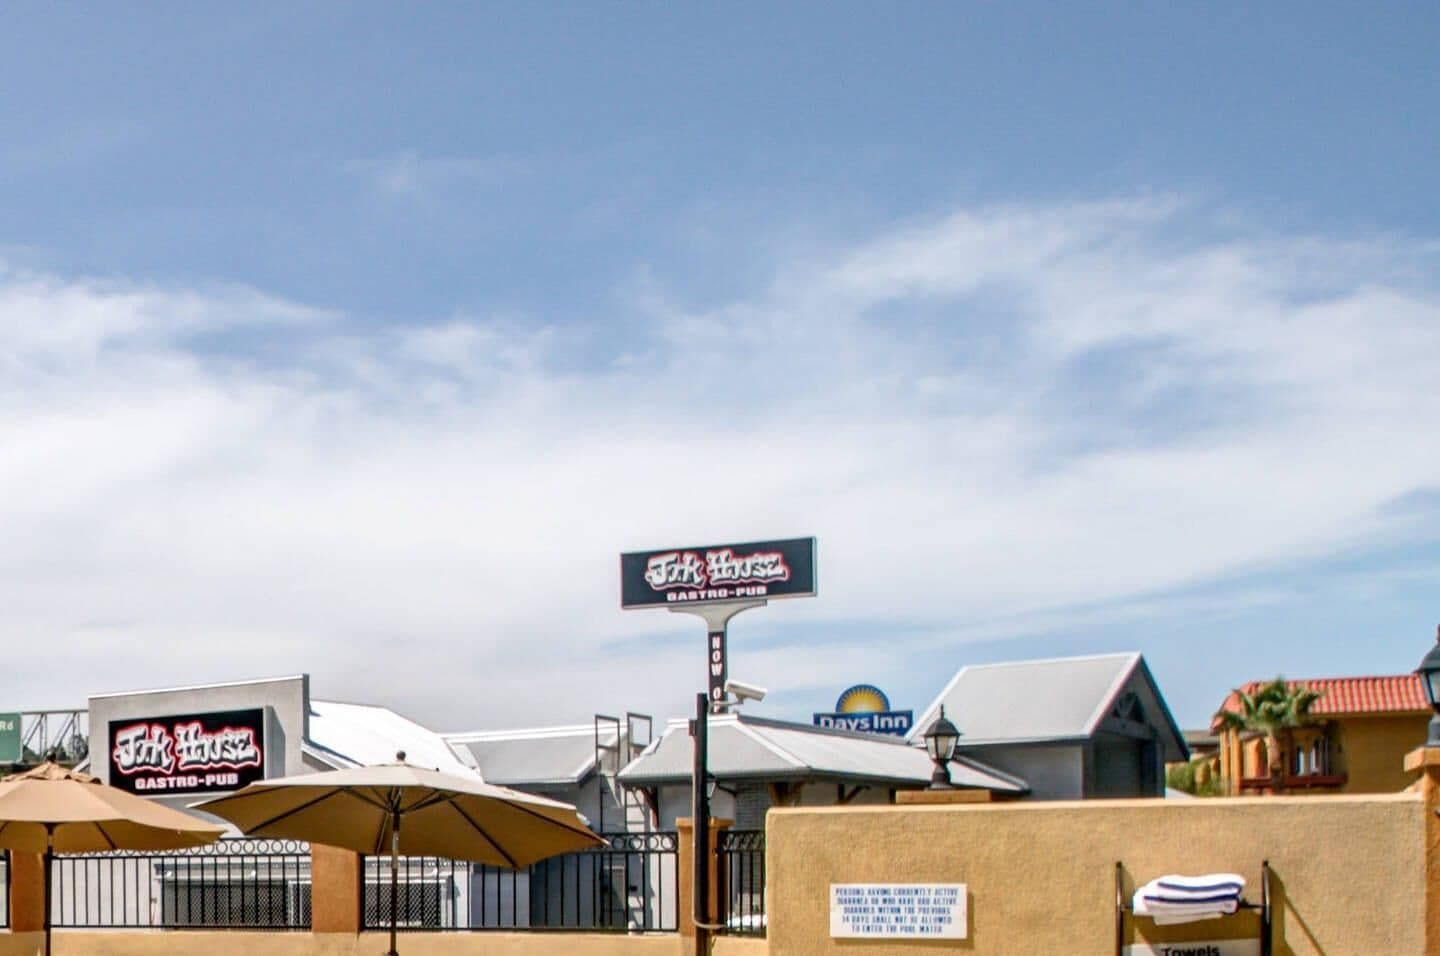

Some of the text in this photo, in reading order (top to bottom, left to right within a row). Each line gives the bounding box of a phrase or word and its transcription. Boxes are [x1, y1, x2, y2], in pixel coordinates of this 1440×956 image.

[666, 585, 768, 602] GASTRO-PUB
[711, 635, 723, 676] NOW
[0, 720, 14, 731] Rd
[873, 714, 908, 729] Inn
[135, 773, 238, 790] GASTRO-PUB
